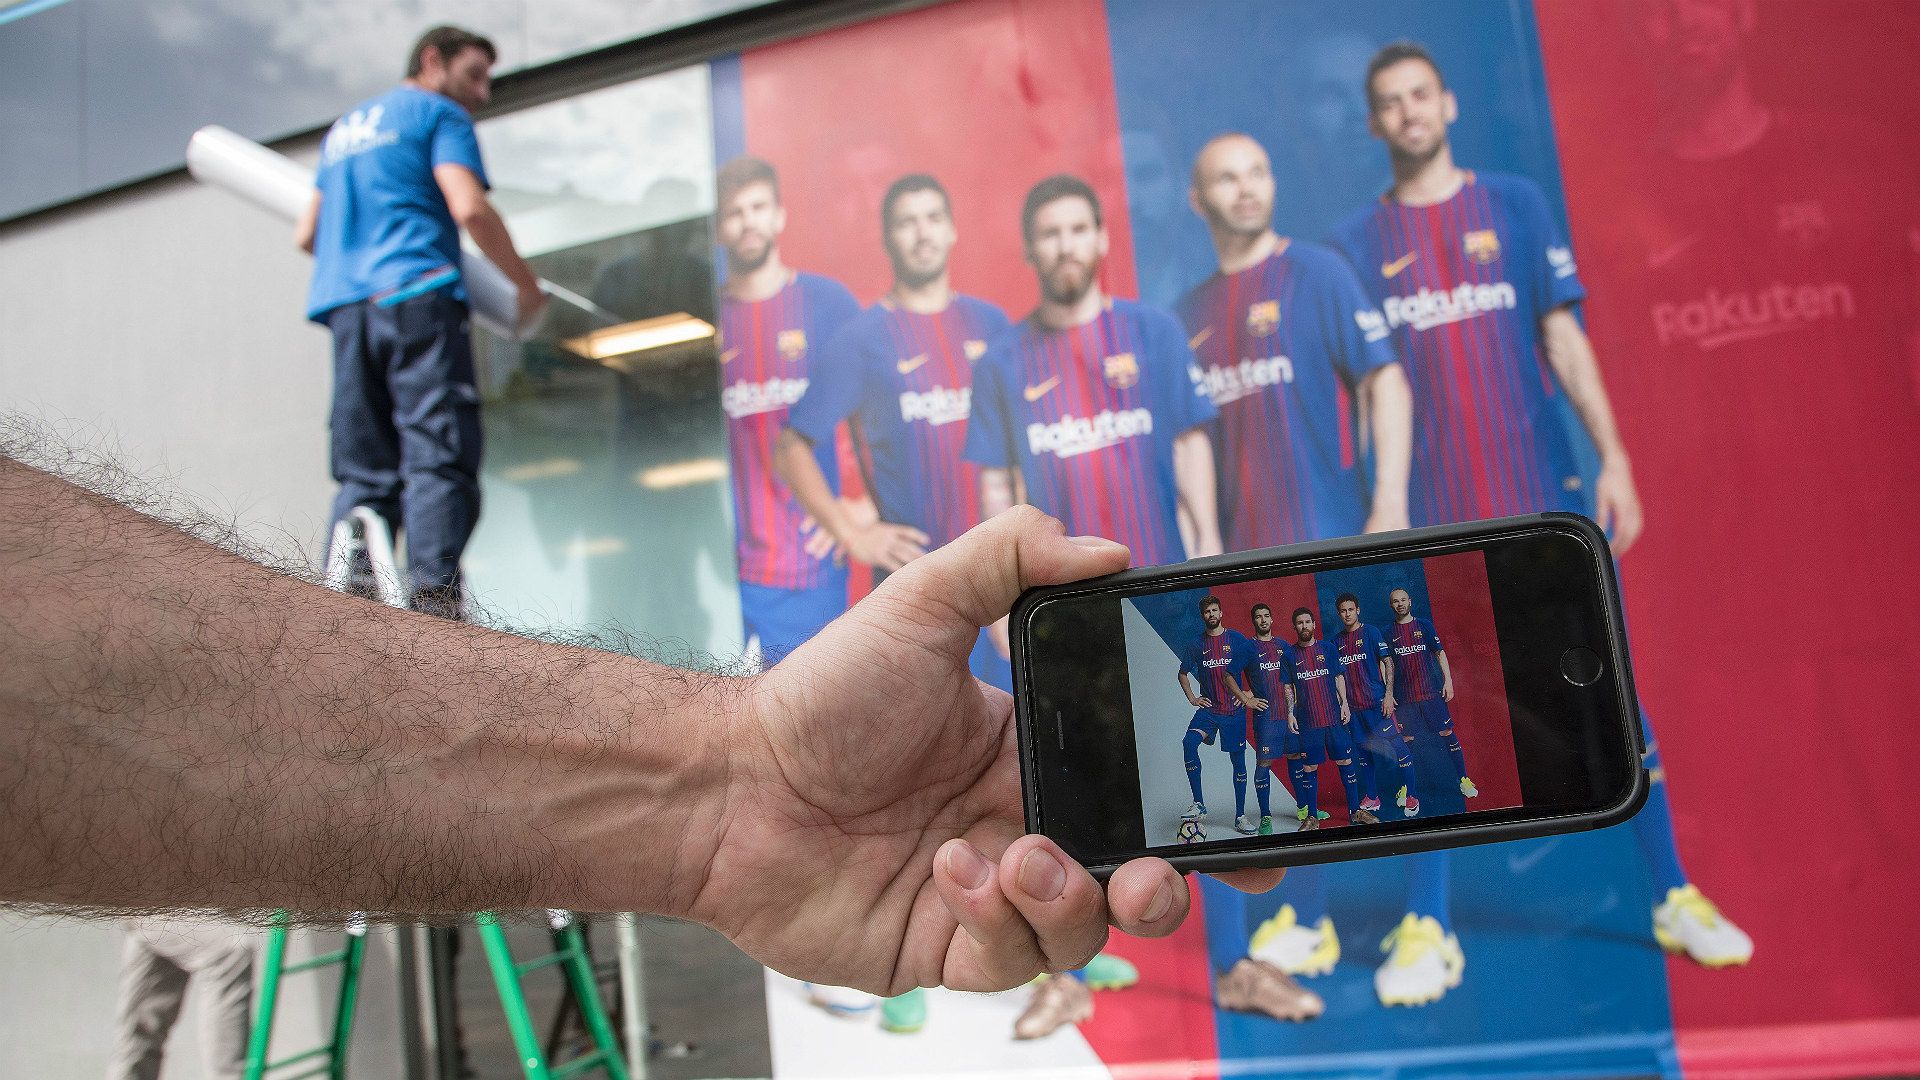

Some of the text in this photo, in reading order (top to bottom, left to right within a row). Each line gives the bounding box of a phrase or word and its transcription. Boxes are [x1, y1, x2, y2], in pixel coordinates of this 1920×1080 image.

[1384, 281, 1517, 332] Rakuten
[1652, 281, 1855, 349] Rakuten
[1026, 407, 1153, 459] Rakuten
[1296, 668, 1329, 681] Rakuten
